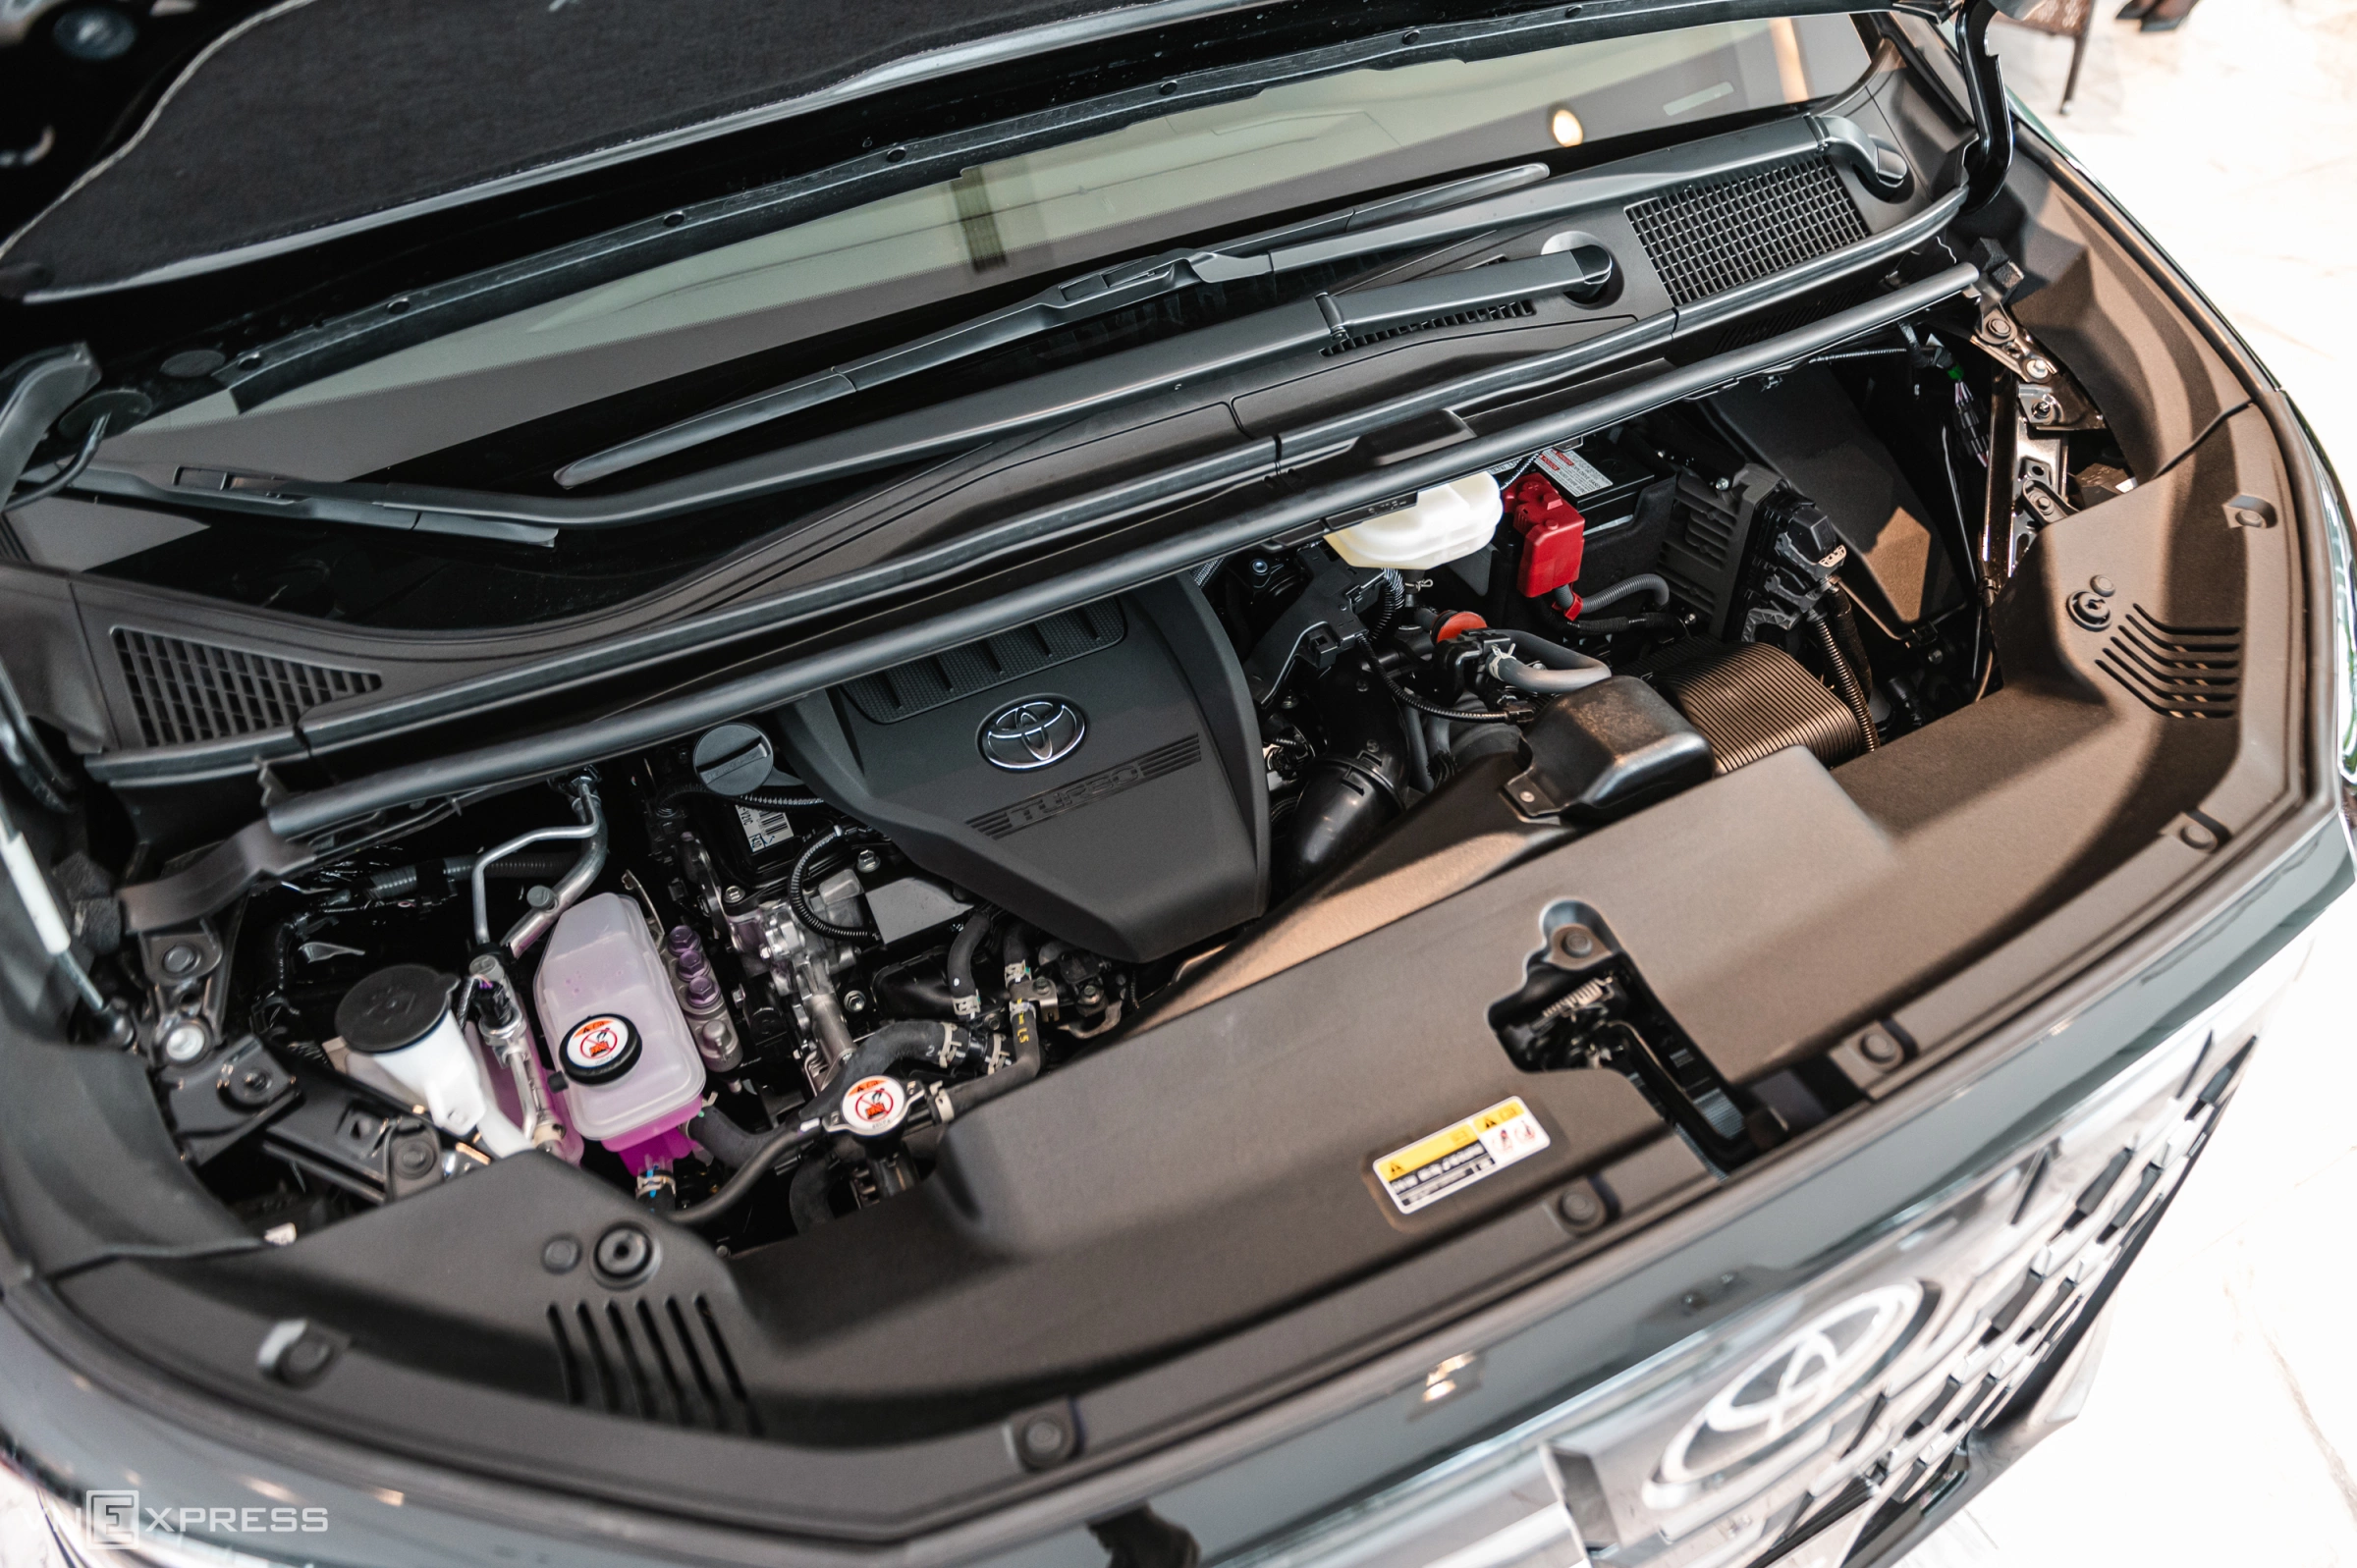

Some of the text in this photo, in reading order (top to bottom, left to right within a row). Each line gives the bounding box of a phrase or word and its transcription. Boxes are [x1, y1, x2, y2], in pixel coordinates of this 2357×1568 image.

[1010, 764, 1139, 822] TURBO
[738, 805, 753, 826] -V21C
[925, 1046, 935, 1056] 2
